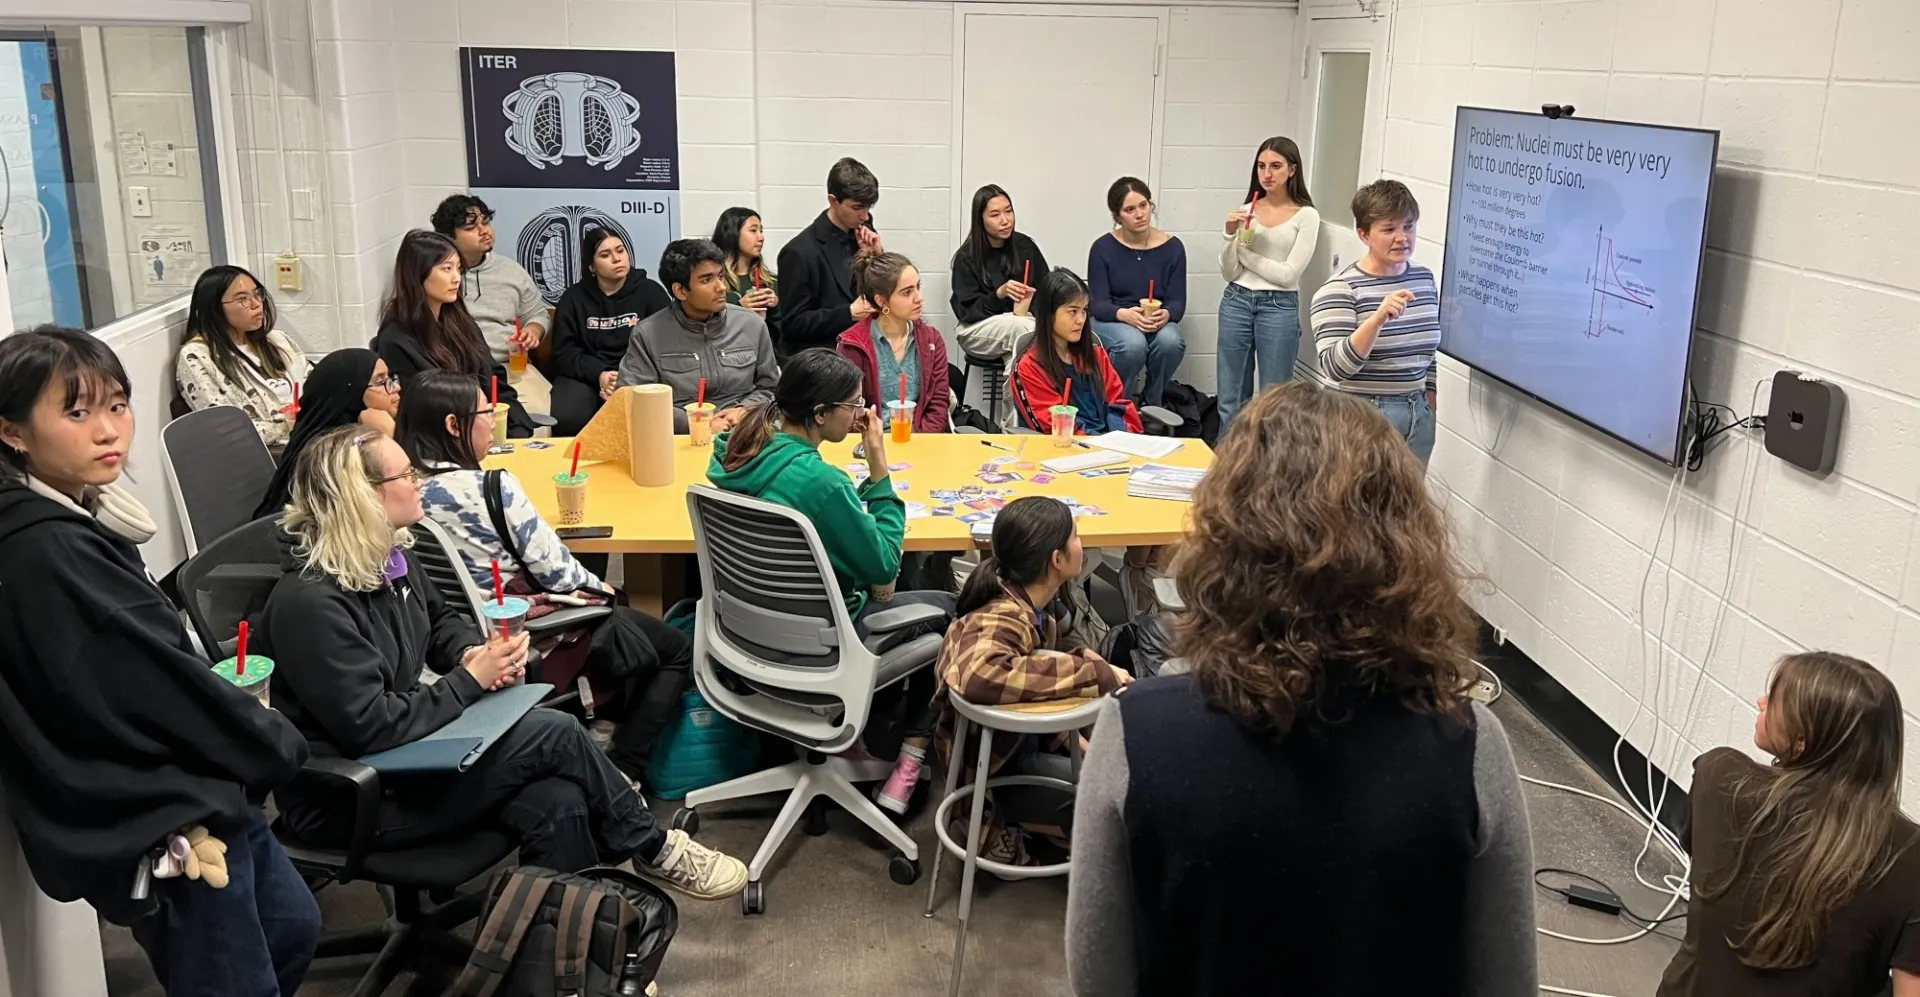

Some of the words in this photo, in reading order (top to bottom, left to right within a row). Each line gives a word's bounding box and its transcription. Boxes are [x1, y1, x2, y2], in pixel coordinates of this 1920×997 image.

[478, 54, 518, 69] ITER
[1470, 126, 1514, 150] Problem:
[1516, 132, 1551, 155] Nuclei
[1552, 140, 1584, 161] must
[1587, 140, 1603, 163] be
[1606, 148, 1636, 174] very
[1639, 152, 1671, 180] very
[1467, 150, 1484, 171] hot
[1485, 155, 1496, 173] to
[1498, 158, 1543, 186] undergo
[1545, 162, 1585, 190] fusion.
[1469, 181, 1481, 193] How
[1482, 182, 1493, 196] hot
[1493, 187, 1498, 197] is
[1499, 189, 1513, 203] very
[1512, 191, 1526, 206] very
[1526, 192, 1542, 206] hot?
[621, 201, 665, 214] DIII-D
[1487, 201, 1504, 213] million
[1505, 206, 1526, 220] degrees
[1466, 213, 1478, 229] Why
[1479, 217, 1493, 231] must
[1494, 220, 1507, 237] they
[1507, 223, 1517, 237] be
[1517, 226, 1529, 240] this
[1529, 229, 1545, 244] hot?
[1471, 231, 1485, 243] Need
[1485, 236, 1504, 250] enough
[1504, 241, 1522, 256] energy
[1523, 245, 1530, 256] to
[1470, 245, 1494, 259] overcome
[1494, 251, 1503, 262] the
[1504, 253, 1528, 269] Coulomb
[1528, 261, 1548, 275] barrier
[1477, 257, 1493, 271] tunnel
[1493, 262, 1514, 279] through
[1460, 268, 1475, 282] What
[1475, 273, 1501, 293] happens
[1500, 283, 1518, 298] when
[1458, 284, 1482, 301] particles
[1482, 291, 1493, 304] get
[1493, 295, 1504, 309] this
[1504, 299, 1519, 314] hot?
